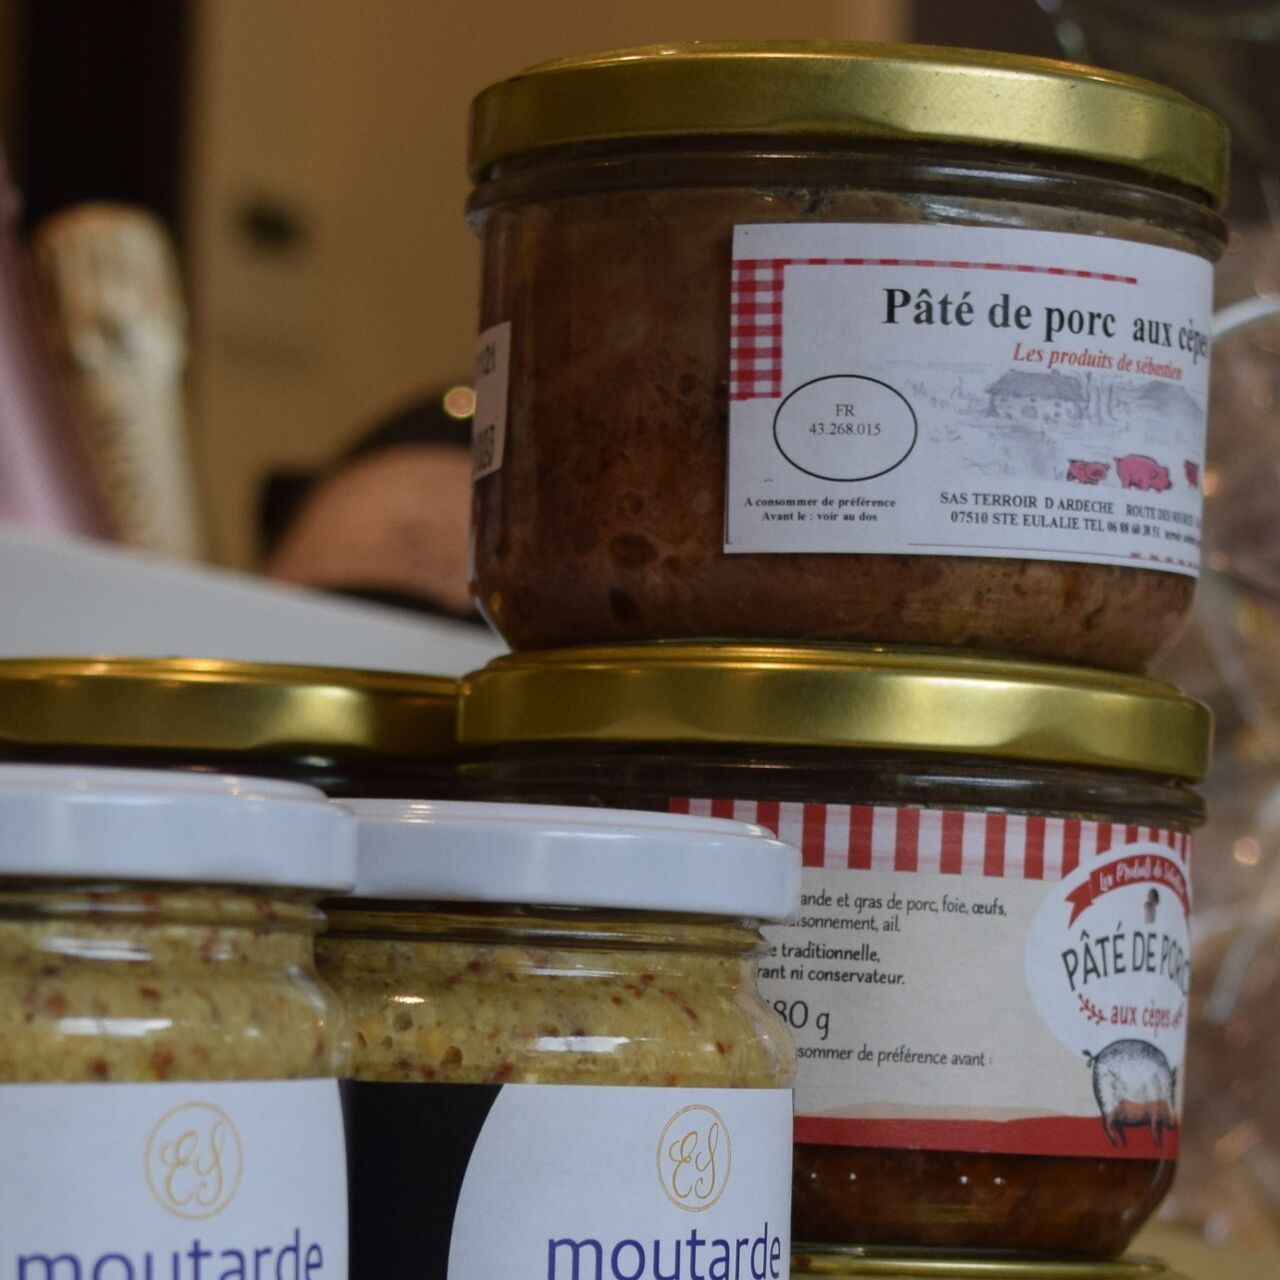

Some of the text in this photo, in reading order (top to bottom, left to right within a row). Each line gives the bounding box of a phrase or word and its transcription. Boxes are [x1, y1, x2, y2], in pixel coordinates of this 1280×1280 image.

[882, 287, 1173, 349] Pâté de porc aux
[1012, 341, 1045, 364] Les
[1049, 347, 1114, 373] produits
[1117, 353, 1133, 373] de
[835, 403, 856, 418] FR
[809, 421, 883, 438] 43.268.015
[753, 498, 818, 509] consommer
[820, 497, 833, 509] de
[835, 497, 897, 512] préférence
[940, 491, 969, 505] SAS
[972, 493, 1038, 509] TERROIR
[1044, 497, 1055, 509] D
[1057, 499, 1115, 515] ARDECHE
[1125, 503, 1157, 521] ROUTE
[762, 511, 879, 524] Avant le voir au dos
[950, 510, 1105, 533] 07510 STE EULALIE TEL
[836, 891, 1008, 918] et gras de porc, foie, œufs,
[882, 914, 901, 933] ail.
[781, 940, 880, 963] traditionnelle,
[1062, 922, 1124, 992] PÂTÉ
[1131, 930, 1158, 973] DE
[790, 965, 906, 986] ni conservateur.
[815, 1006, 831, 1040] g
[1110, 998, 1171, 1037] aux cèpes
[856, 1044, 986, 1068] de préférence avant
